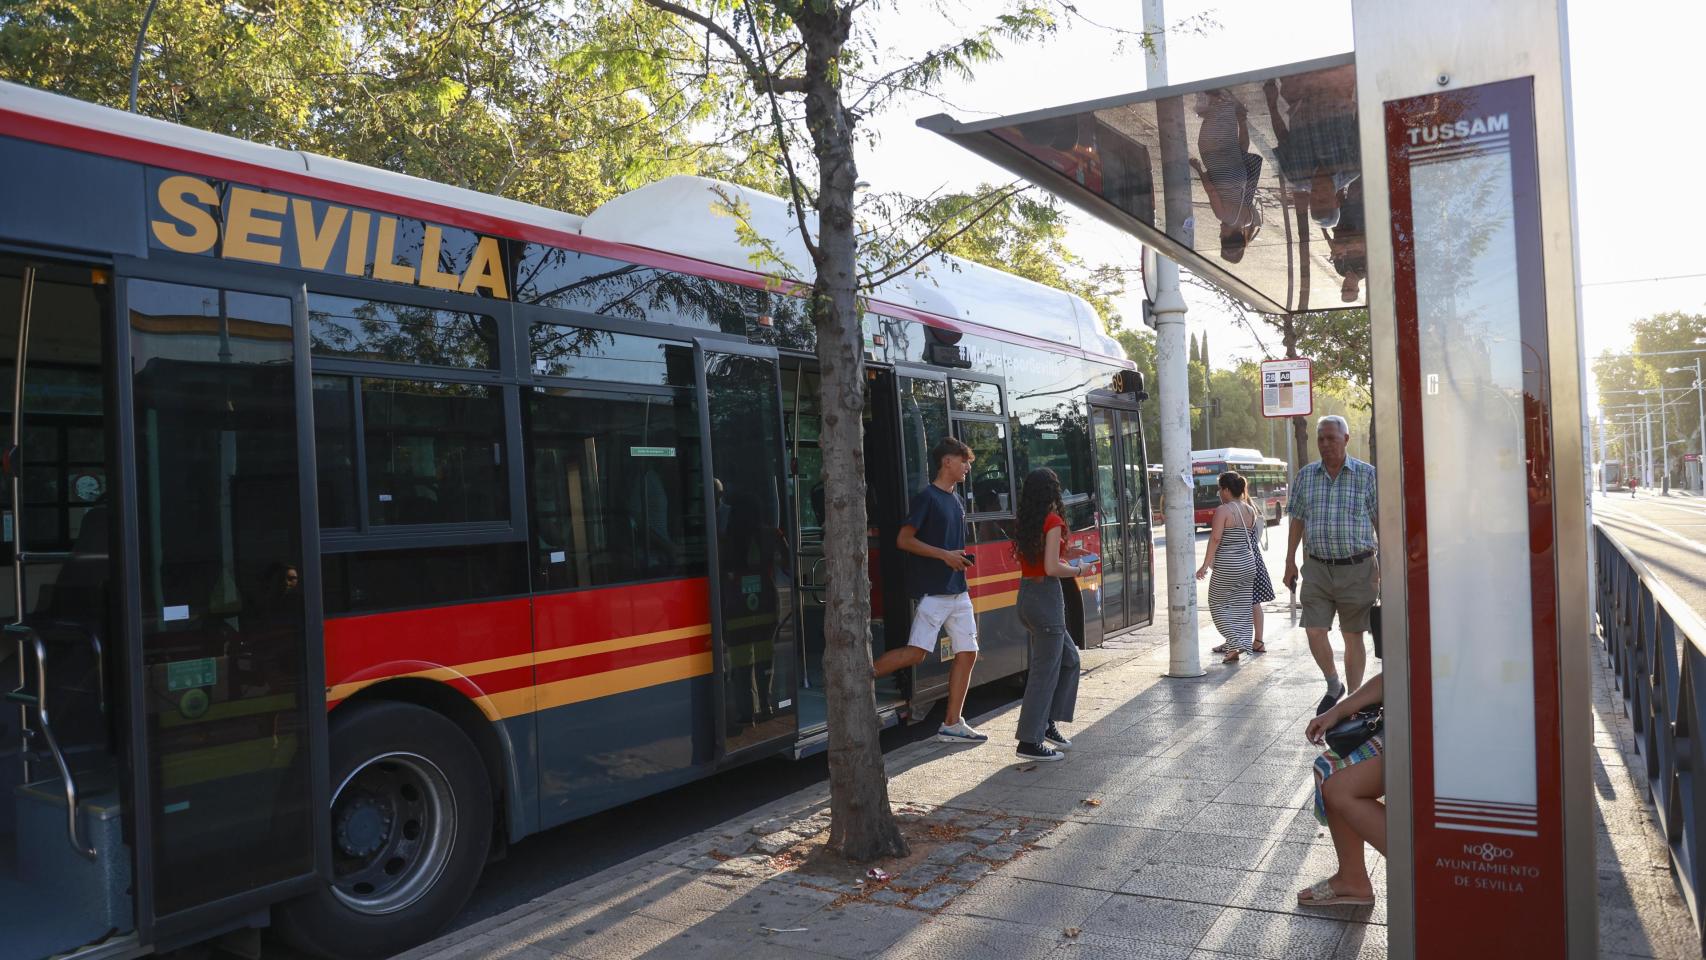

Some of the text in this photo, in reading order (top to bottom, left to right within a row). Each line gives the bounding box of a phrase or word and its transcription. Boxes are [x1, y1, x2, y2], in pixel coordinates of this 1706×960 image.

[1407, 113, 1509, 145] TUSSAM
[151, 175, 508, 300] SEVILLA
[1435, 857, 1540, 878] AYUNTAMIENTO
[1454, 876, 1524, 893] DE SEVILLA
